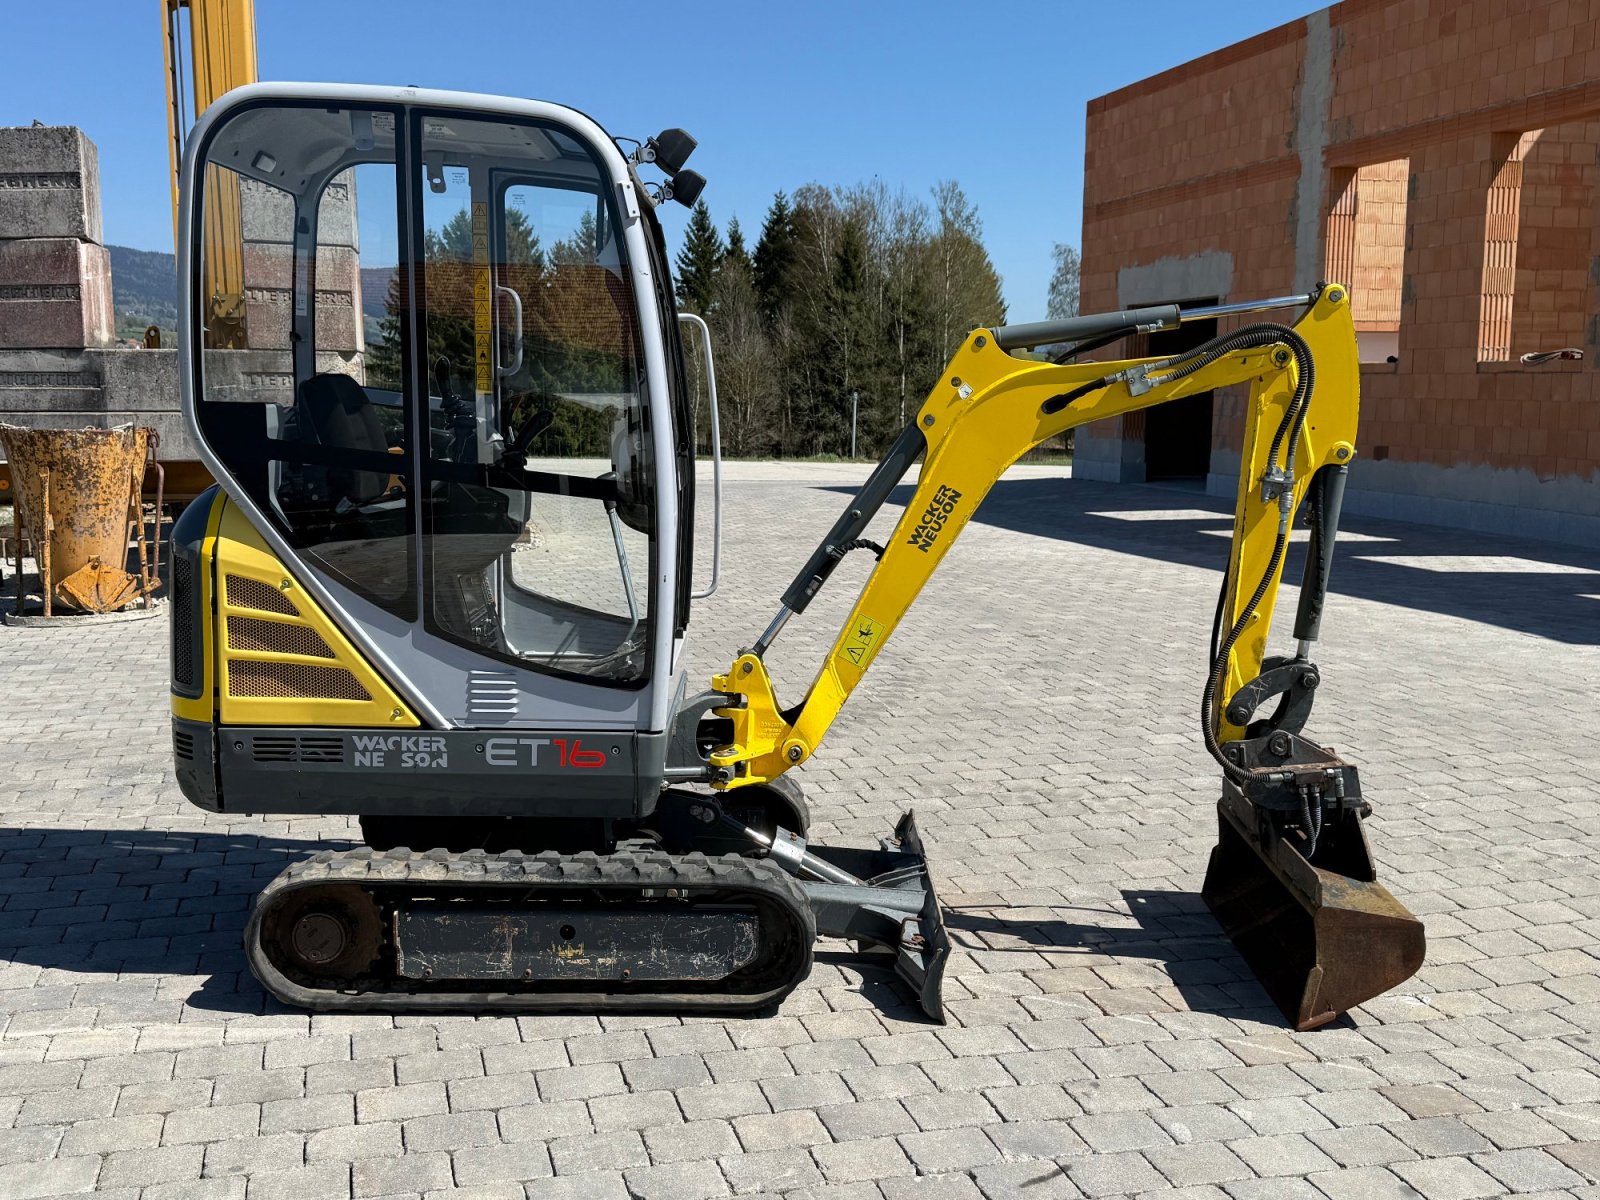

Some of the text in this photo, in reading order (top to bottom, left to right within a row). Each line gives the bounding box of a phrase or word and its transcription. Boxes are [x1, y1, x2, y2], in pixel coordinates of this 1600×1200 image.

[246, 288, 351, 305] LIEBRR
[907, 484, 953, 545] WACKER
[918, 489, 962, 553] NEUSON
[352, 736, 447, 752] WACKER
